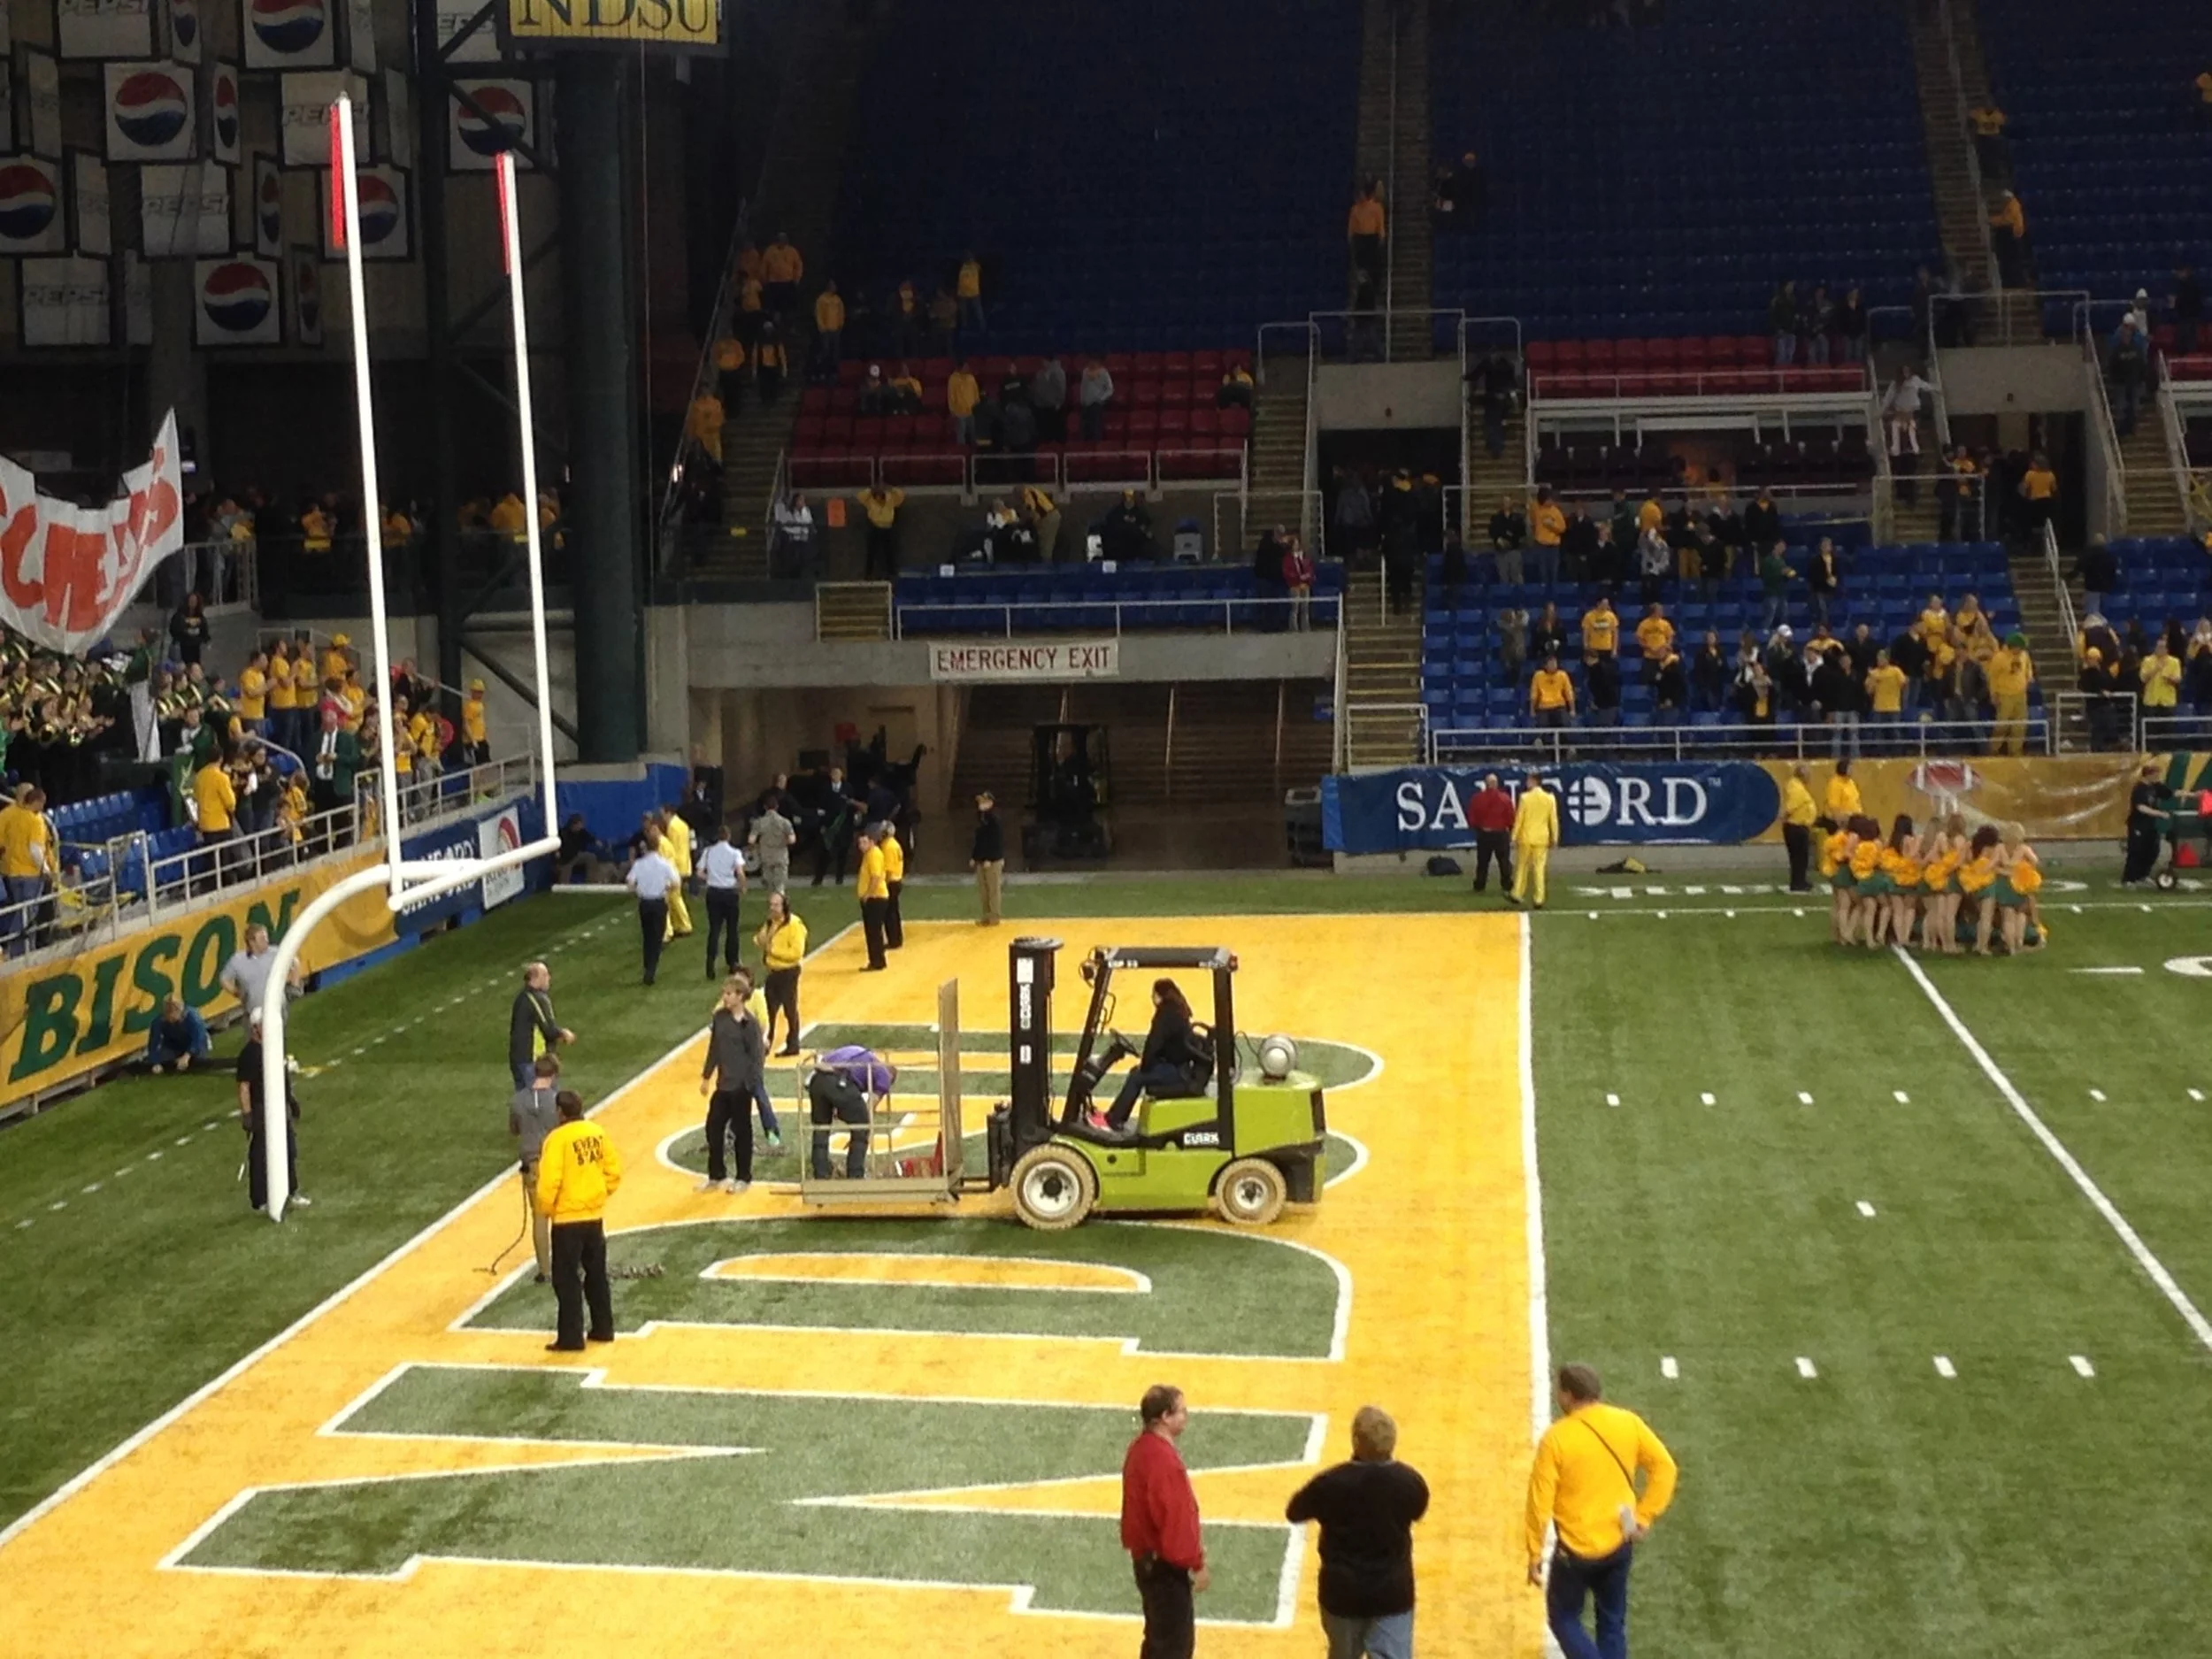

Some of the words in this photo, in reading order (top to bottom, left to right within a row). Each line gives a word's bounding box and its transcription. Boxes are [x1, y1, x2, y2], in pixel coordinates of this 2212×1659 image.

[937, 649, 1057, 672] EMERGENCY
[1069, 646, 1110, 669] EXIT
[1396, 775, 1708, 832] SAORD
